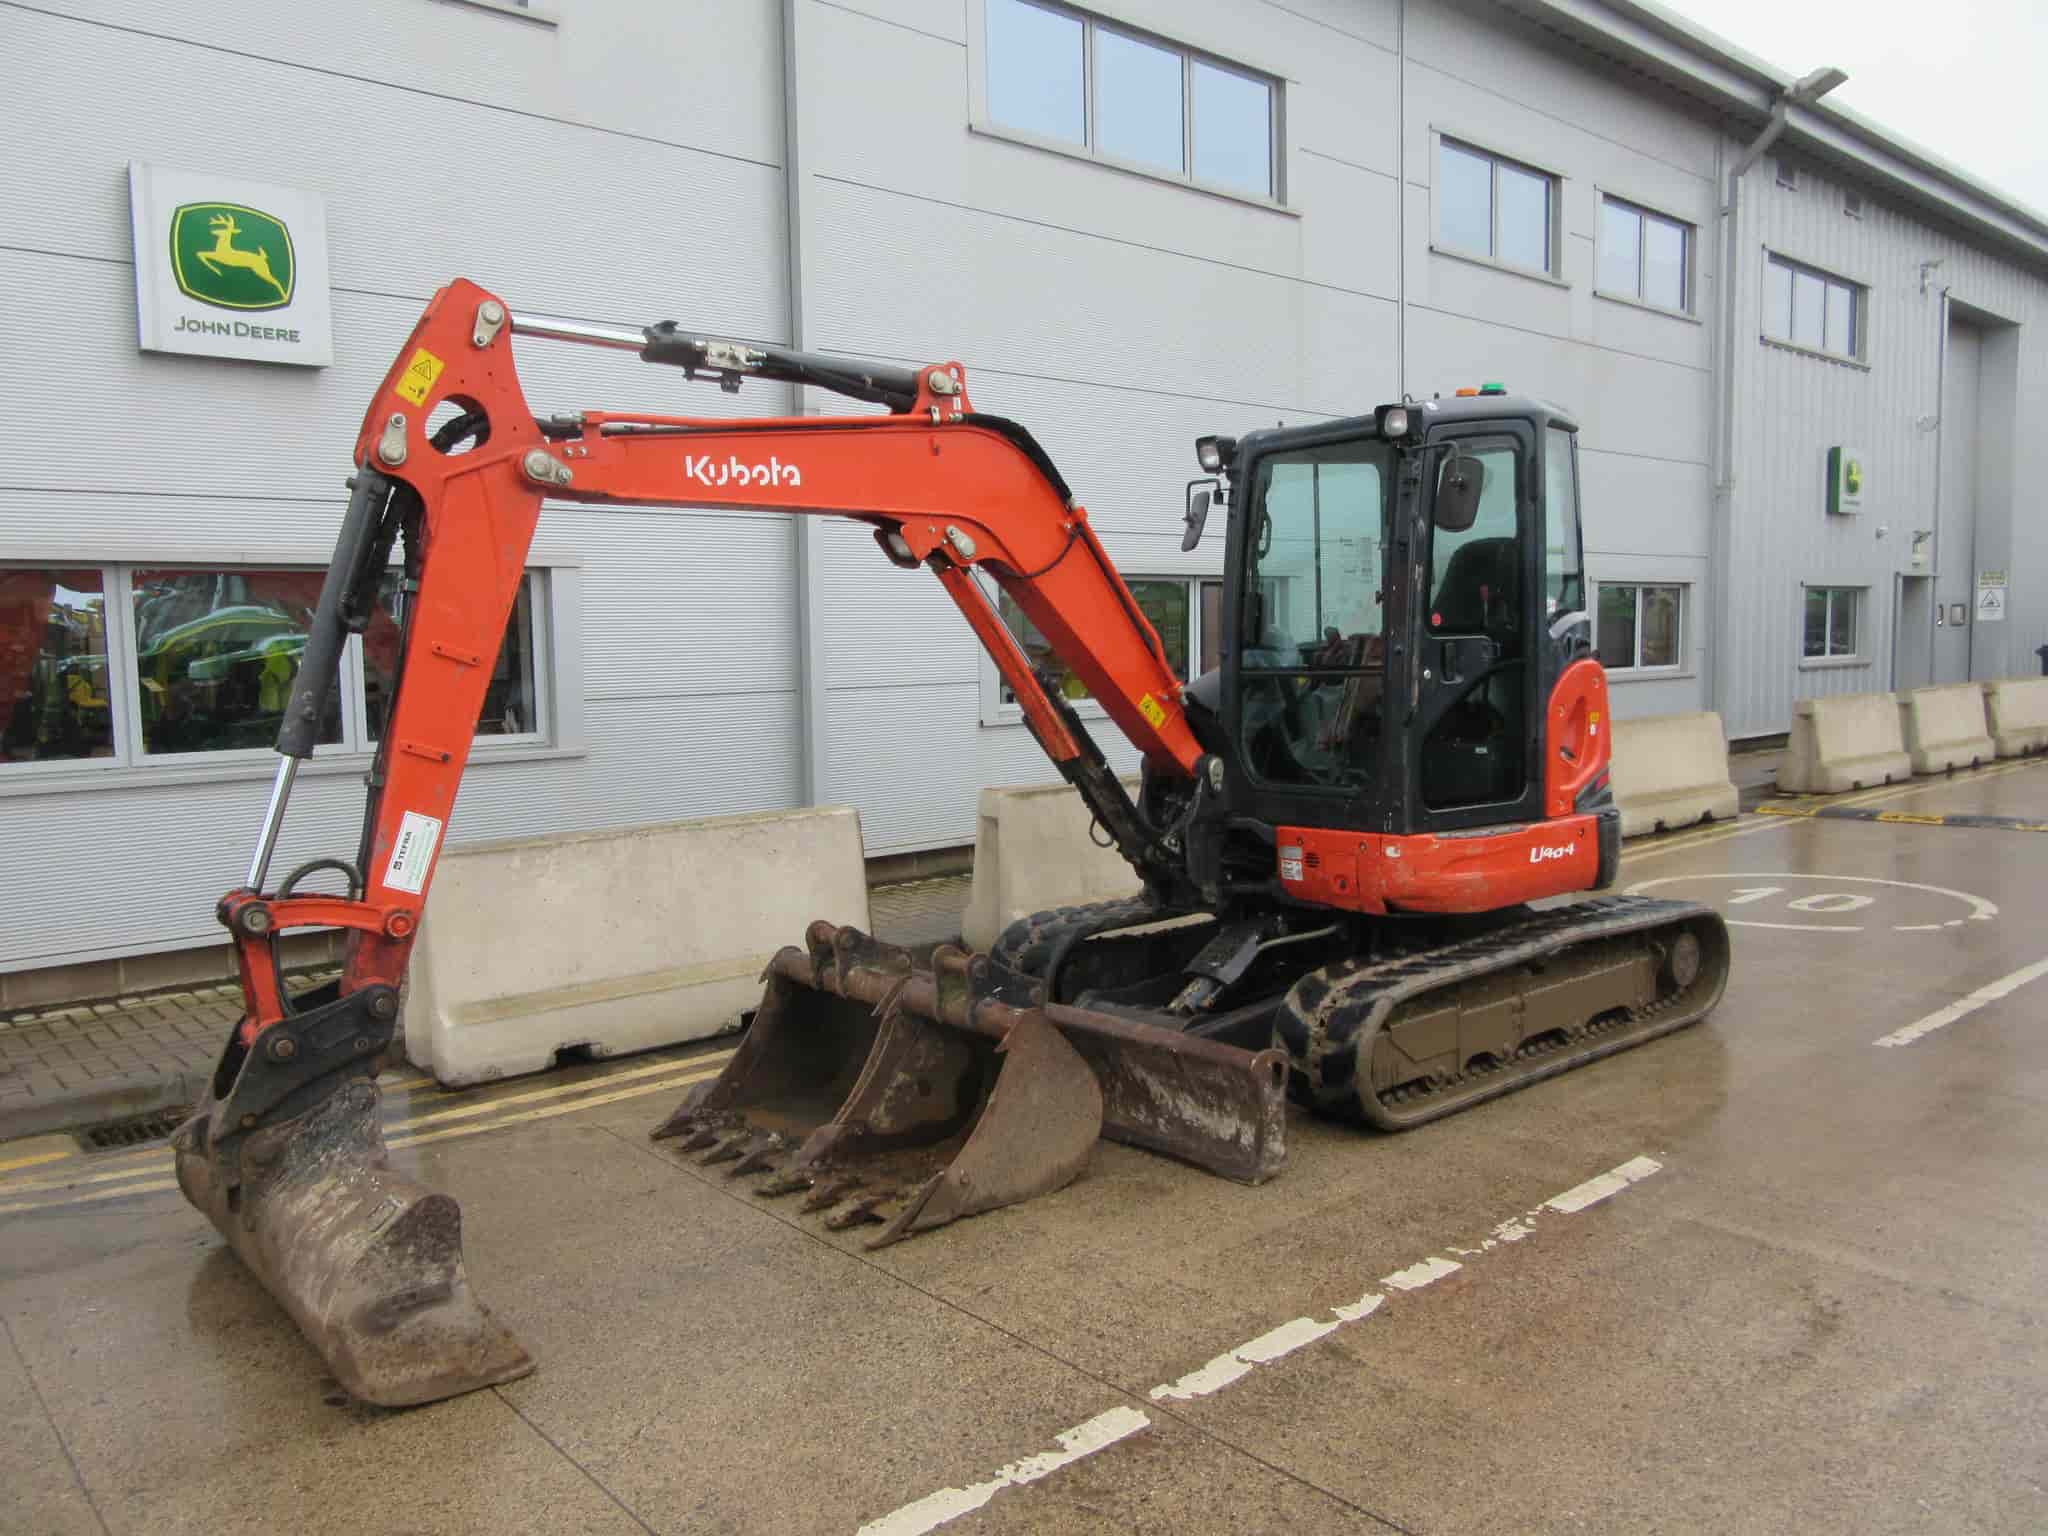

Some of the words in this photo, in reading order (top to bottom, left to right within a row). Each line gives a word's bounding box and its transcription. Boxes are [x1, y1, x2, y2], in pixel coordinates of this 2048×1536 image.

[173, 315, 231, 336] JOHN
[234, 321, 301, 343] DEERE
[685, 455, 801, 486] Kubota
